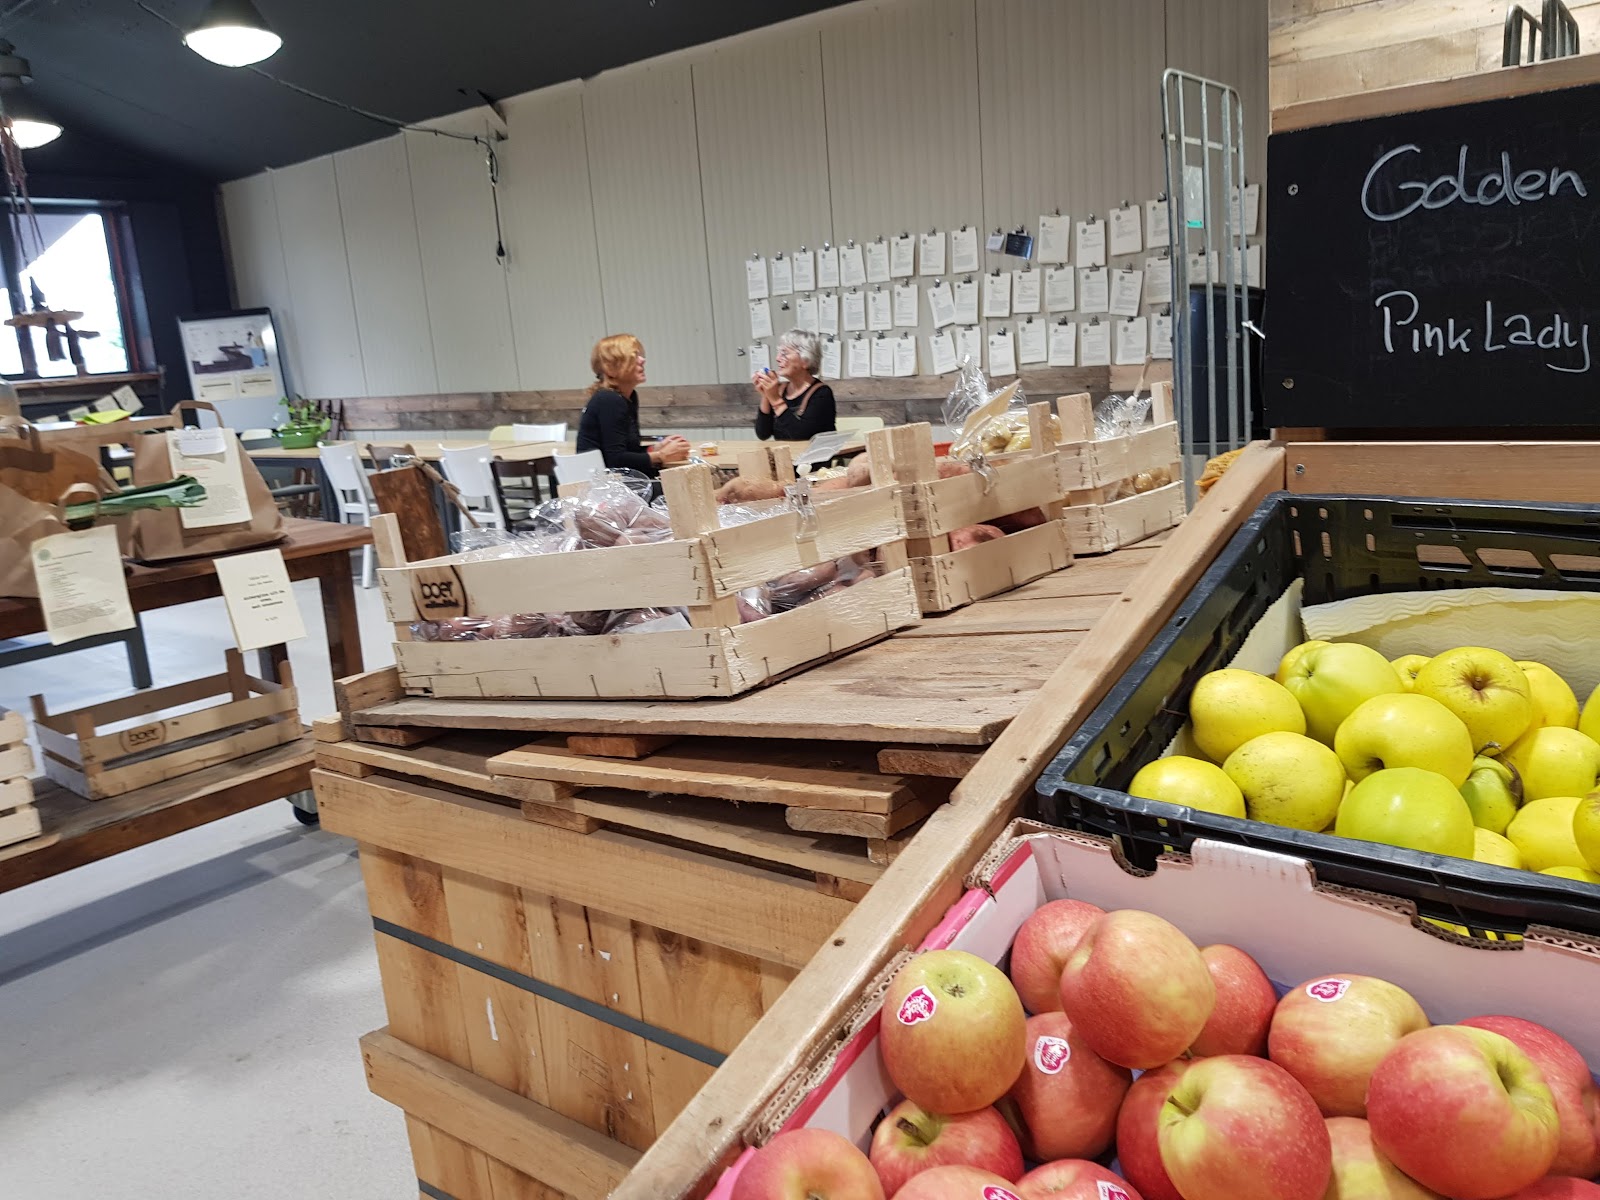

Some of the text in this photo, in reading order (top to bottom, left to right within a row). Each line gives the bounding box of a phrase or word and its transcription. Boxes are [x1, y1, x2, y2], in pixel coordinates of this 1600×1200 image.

[1361, 143, 1588, 222] Golden
[1375, 290, 1591, 373] Pink Lady
[416, 574, 453, 599] boer
